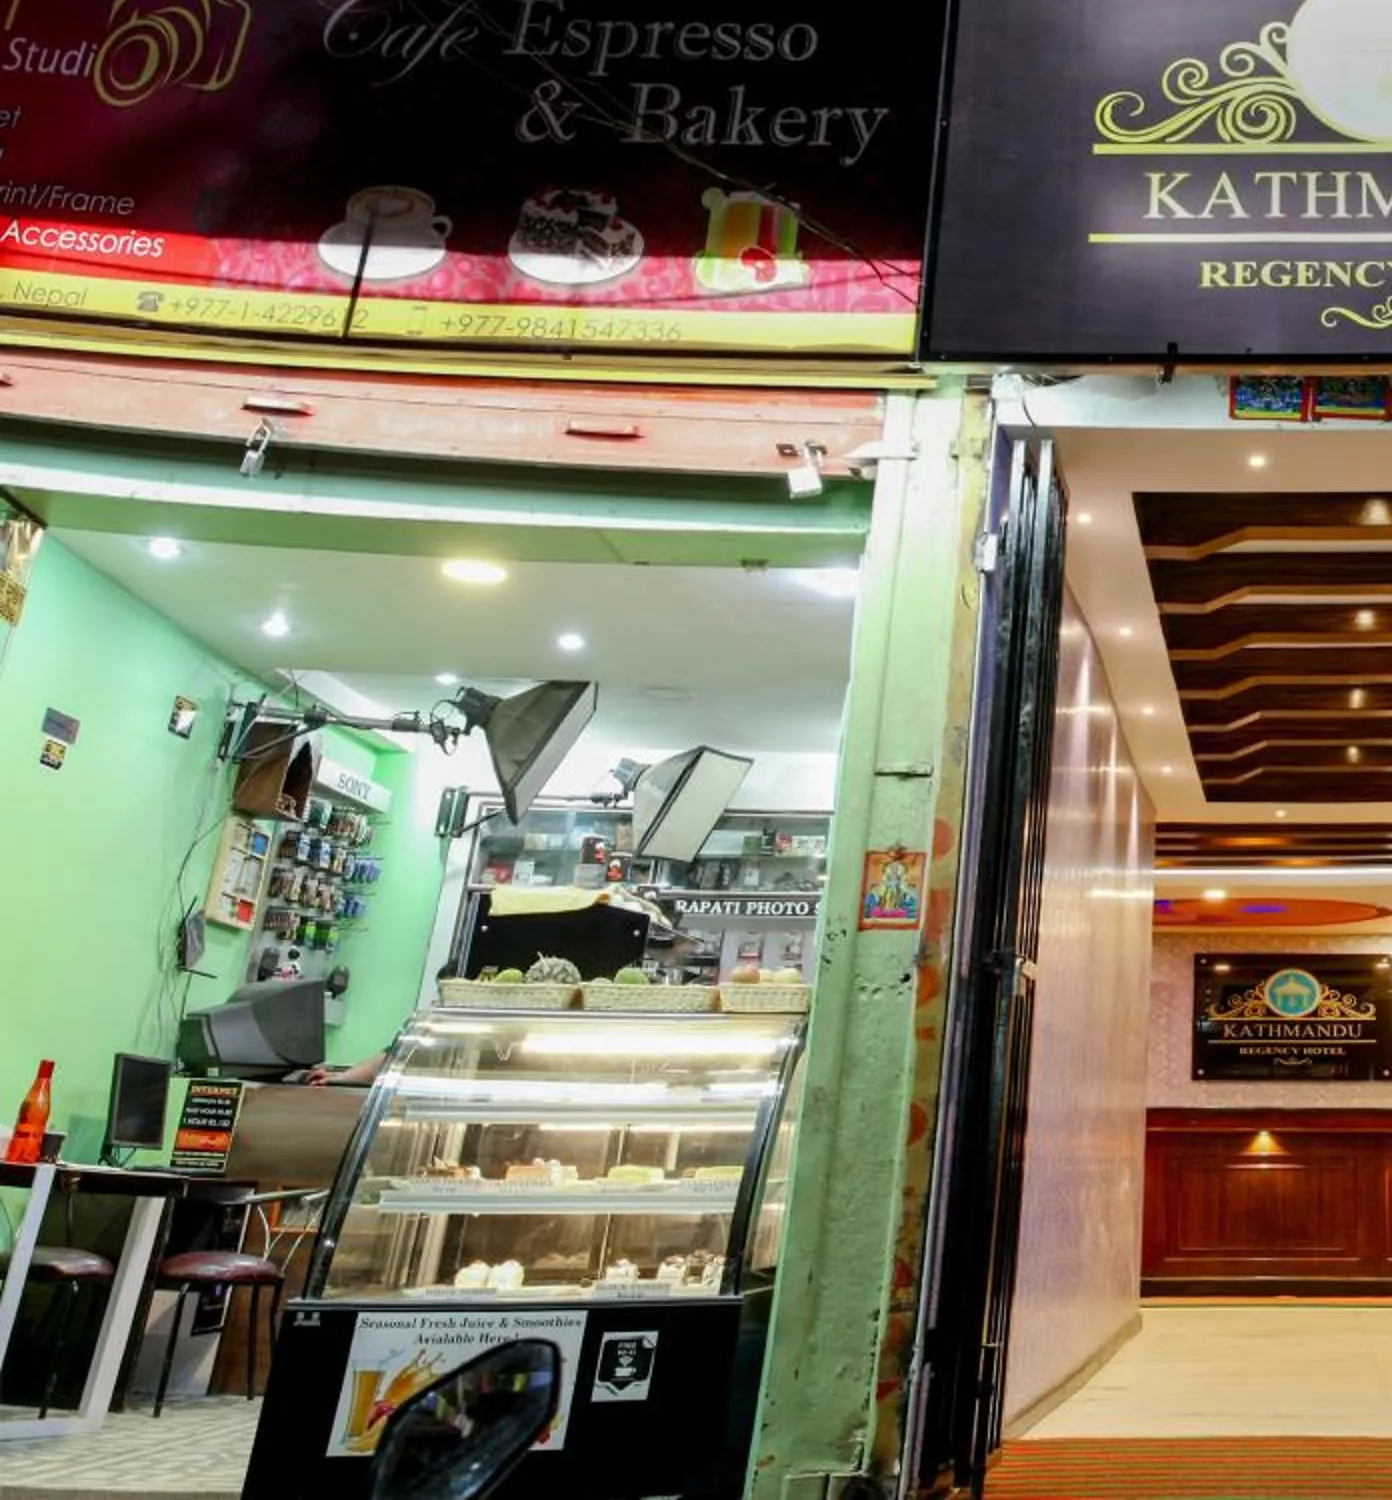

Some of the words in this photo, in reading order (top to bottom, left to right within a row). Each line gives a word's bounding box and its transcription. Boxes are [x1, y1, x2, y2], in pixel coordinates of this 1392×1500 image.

[517, 79, 579, 143] &
[620, 82, 889, 166] Bakery
[1, 219, 165, 258] Accessories
[13, 279, 86, 308] Nepal
[336, 773, 373, 800] SONY
[745, 901, 809, 916] PHOTO
[1223, 1023, 1363, 1039] KATHMANDU
[1239, 1046, 1300, 1056] REGENCY
[1303, 1046, 1347, 1056] HOTEL
[359, 1315, 417, 1330] Seasonal
[420, 1315, 456, 1329] Fresh
[459, 1316, 497, 1330] Juice
[499, 1316, 510, 1329] &
